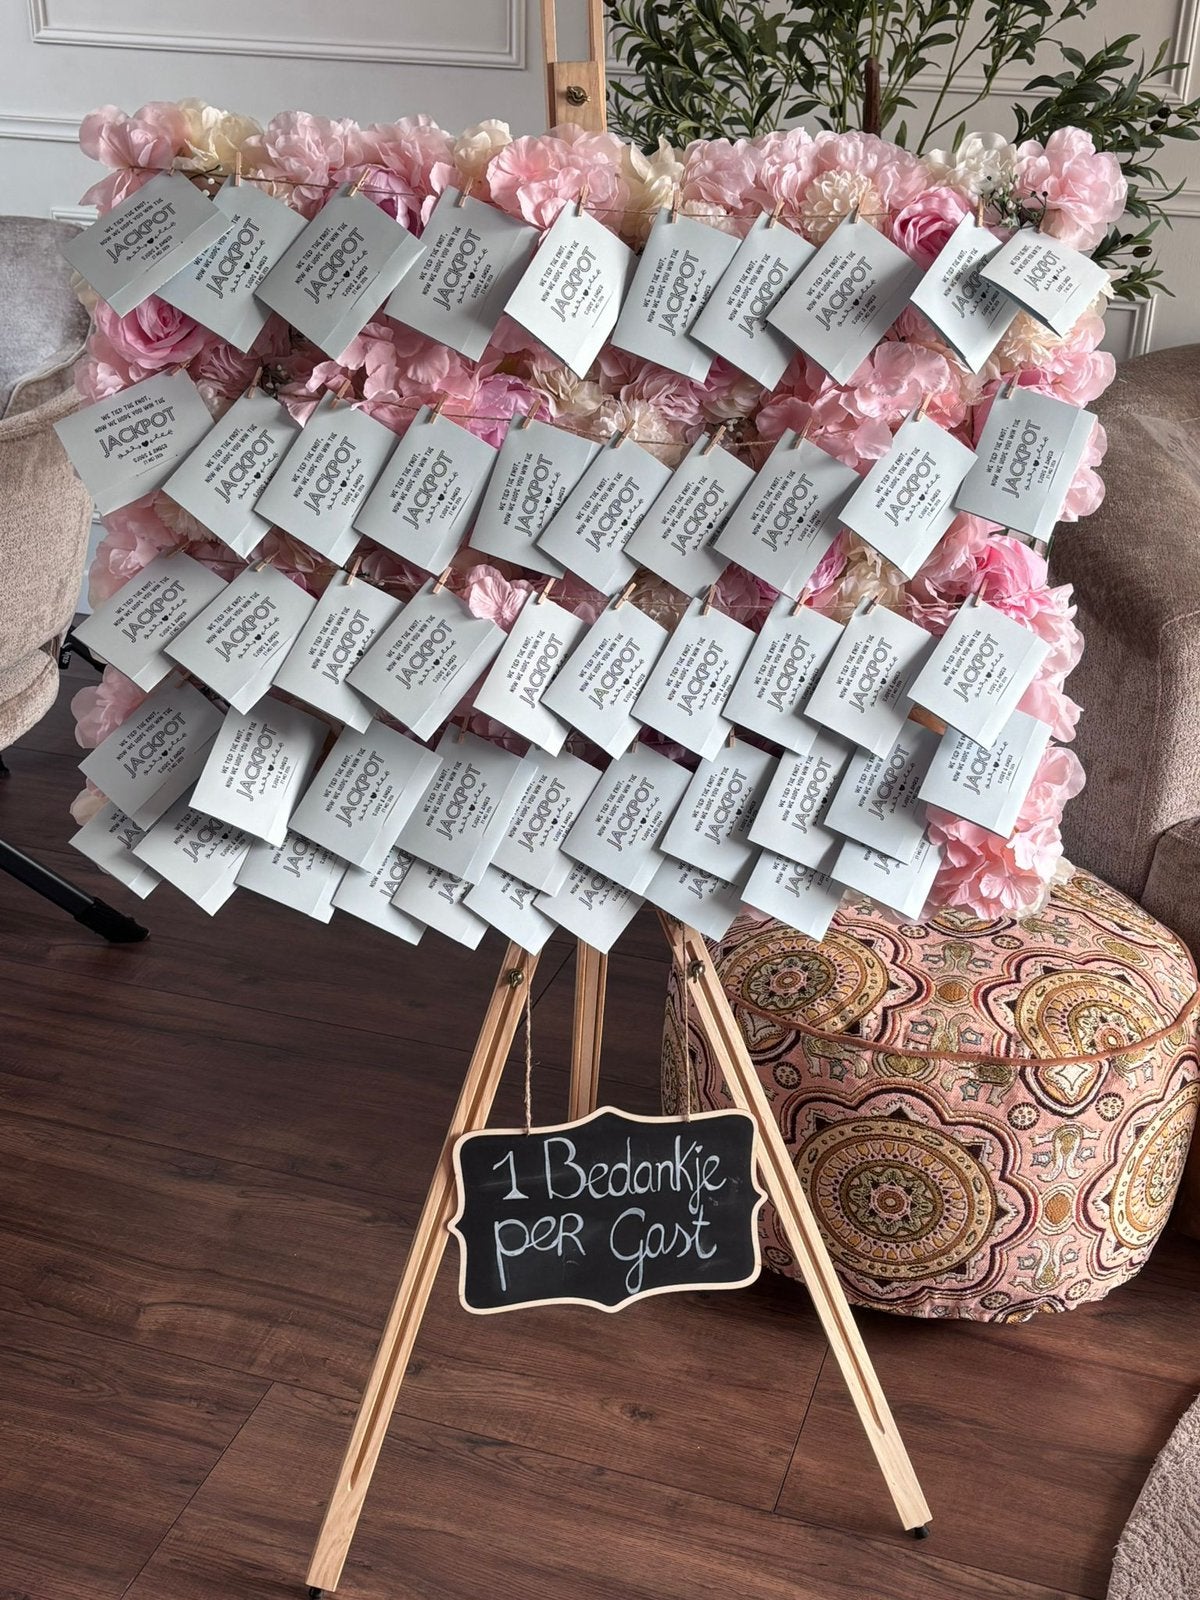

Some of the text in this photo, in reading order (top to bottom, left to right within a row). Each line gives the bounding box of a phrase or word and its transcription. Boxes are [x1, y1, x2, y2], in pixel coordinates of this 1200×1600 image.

[106, 202, 176, 264] JACKPOT
[206, 218, 260, 299] JACKPOT
[304, 227, 364, 304] JACKPOT
[432, 228, 481, 311] JACKPOT
[1023, 251, 1061, 291] JACKPOT
[550, 245, 596, 322] JACKPOT
[658, 250, 699, 337] JACKPOT
[738, 257, 788, 339] JACKPOT
[815, 256, 872, 331] JACKPOT
[99, 406, 175, 458] JACKPOT
[214, 429, 275, 504] JACKPOT
[1001, 419, 1041, 498] JACKPOT
[303, 436, 356, 516] JACKPOT
[402, 450, 453, 530] JACKPOT
[514, 454, 553, 538] JACKPOT
[585, 476, 640, 553] JACKPOT
[761, 473, 813, 552] JACKPOT
[884, 452, 936, 527] JACKPOT
[670, 480, 724, 557] JACKPOT
[122, 580, 185, 642] JACKPOT
[215, 596, 276, 662] JACKPOT
[322, 609, 370, 685] JACKPOT
[395, 619, 452, 690] JACKPOT
[519, 633, 563, 709] JACKPOT
[588, 637, 640, 710] JACKPOT
[677, 640, 723, 716] JACKPOT
[767, 634, 810, 713] JACKPOT
[848, 637, 892, 714] JACKPOT
[953, 633, 999, 703] JACKPOT
[123, 712, 186, 779] JACKPOT
[236, 723, 277, 802] JACKPOT
[868, 744, 909, 821] JACKPOT
[963, 741, 995, 795] JACK
[335, 750, 384, 828] JACKPOT
[436, 763, 481, 841] JACKPOT
[518, 777, 565, 853] JACKPOT
[606, 777, 655, 852] JACKPOT
[704, 768, 747, 845] JACKPOT
[791, 757, 831, 834] JACKPOT
[183, 818, 224, 863] JACK
[380, 849, 413, 897] JACK
[493, 1135, 727, 1214] 1 Bedankje
[609, 1206, 717, 1294] Gast
